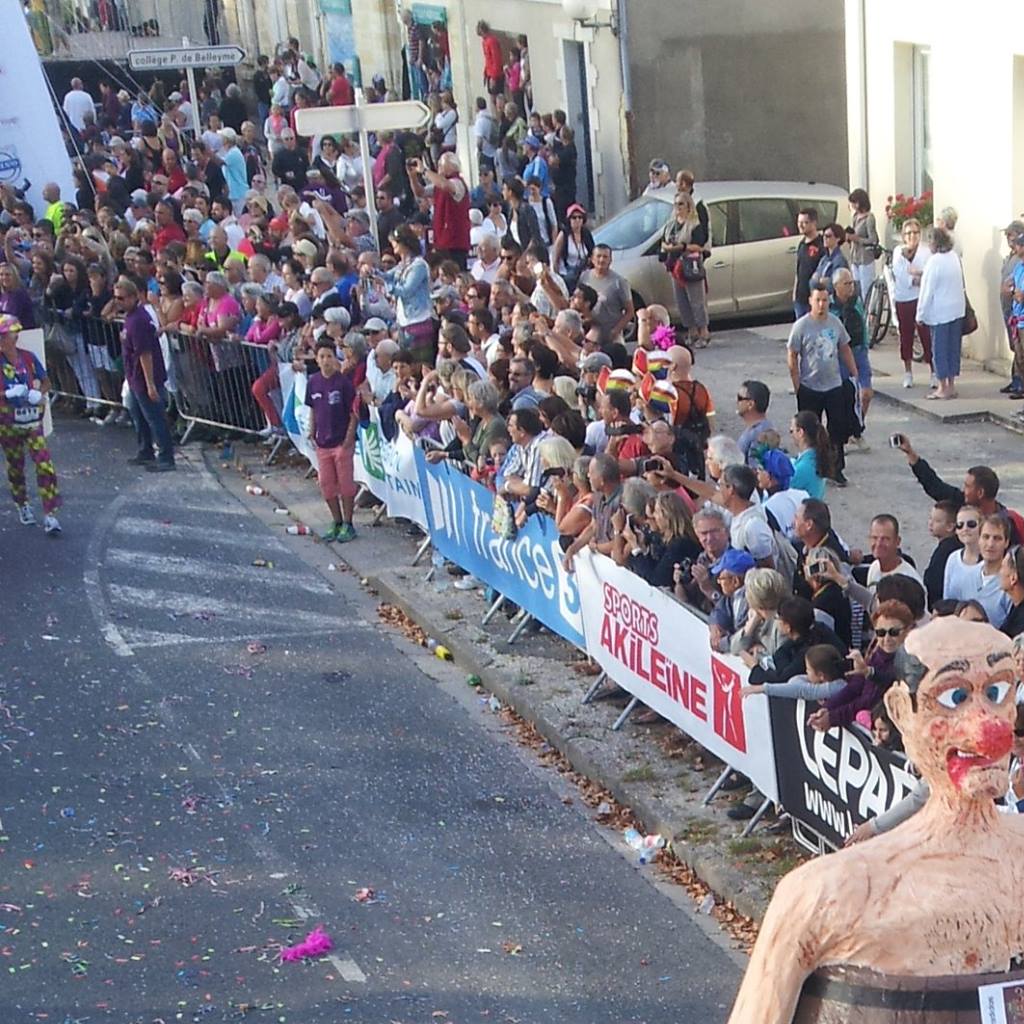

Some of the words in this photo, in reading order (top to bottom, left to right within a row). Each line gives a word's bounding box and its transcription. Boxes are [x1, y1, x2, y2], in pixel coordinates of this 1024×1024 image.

[181, 53, 193, 62] de
[194, 51, 236, 62] Belleyme
[603, 582, 659, 646] SPORTS
